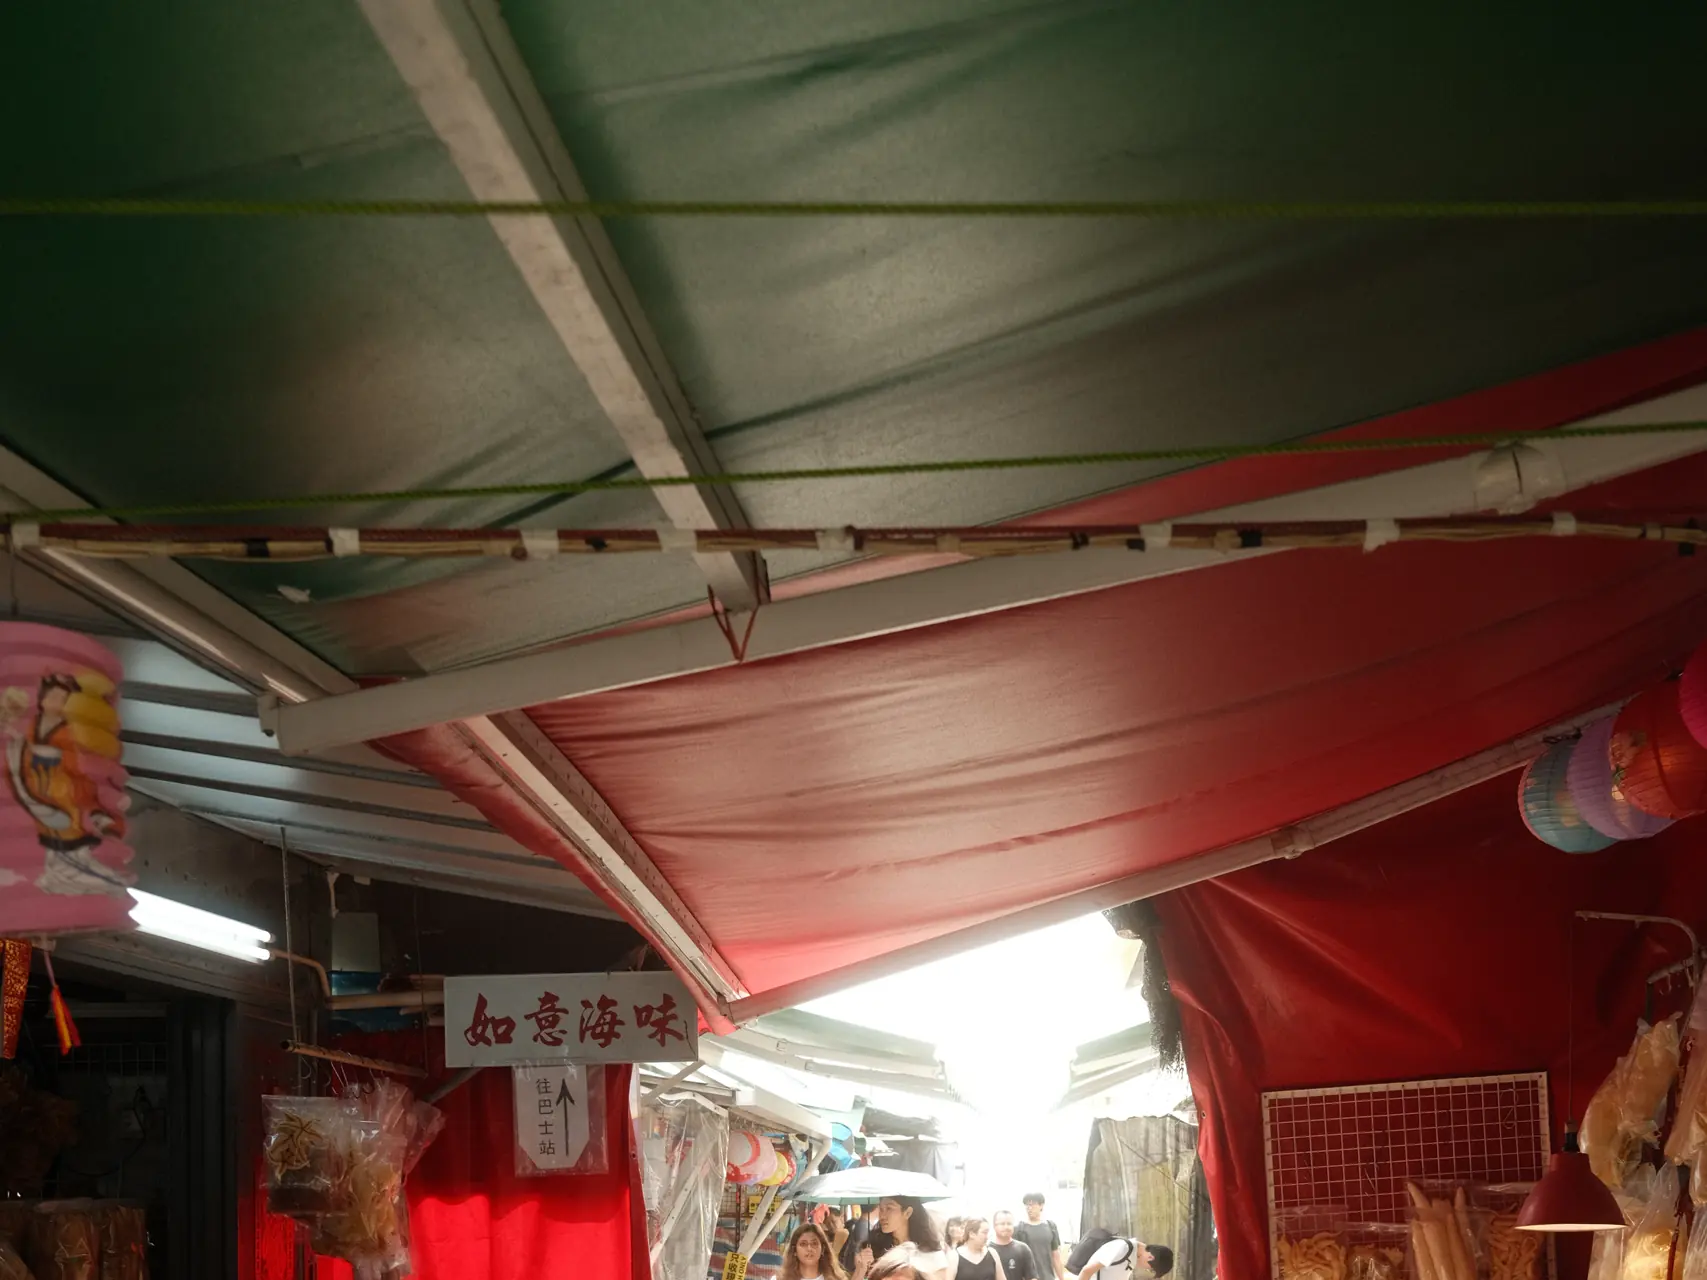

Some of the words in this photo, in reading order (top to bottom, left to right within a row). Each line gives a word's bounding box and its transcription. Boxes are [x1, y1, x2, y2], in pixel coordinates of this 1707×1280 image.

[463, 990, 686, 1048] 如意海味
[536, 1077, 556, 1156] 往巴士站
[739, 1256, 747, 1274] ONLY
